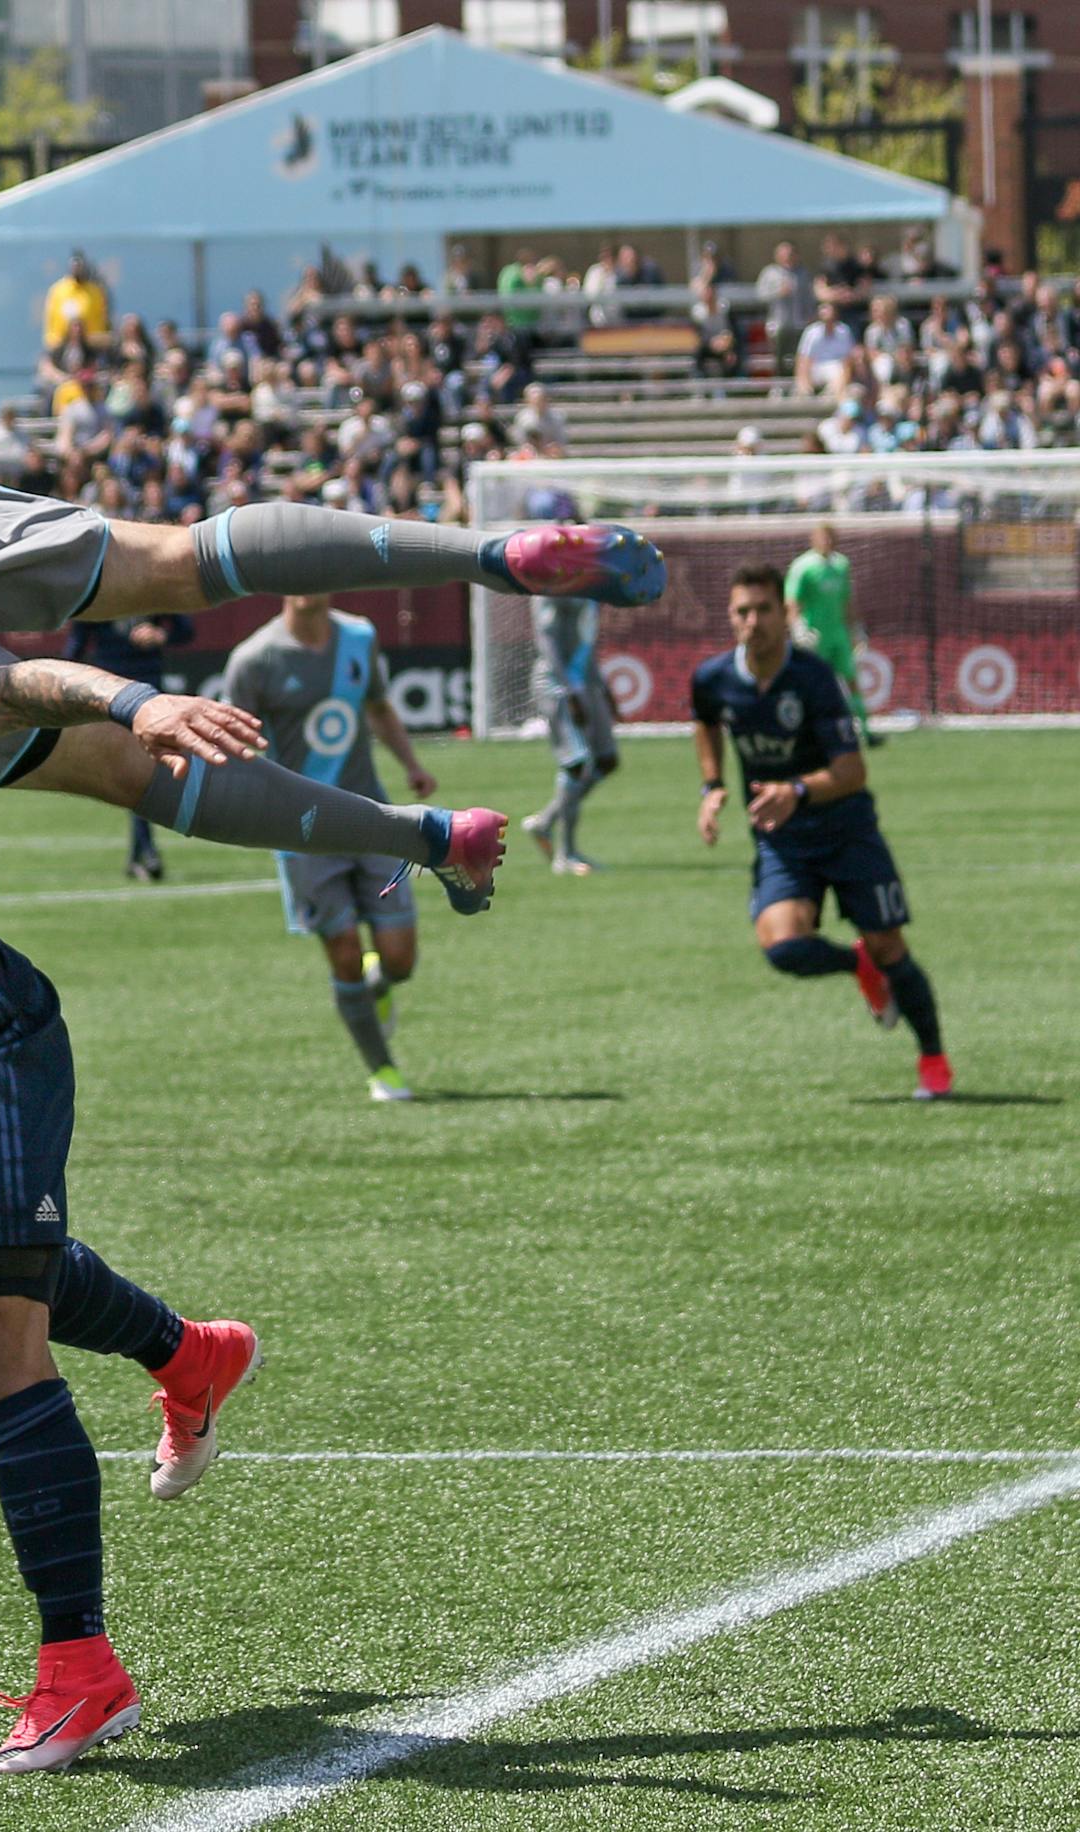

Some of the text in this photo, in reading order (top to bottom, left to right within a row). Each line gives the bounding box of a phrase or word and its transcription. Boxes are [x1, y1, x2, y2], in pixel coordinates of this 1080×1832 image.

[328, 107, 613, 140] MINNESOTA UNITED
[330, 138, 513, 168] TEAM STORE
[34, 1211, 61, 1222] adidas
